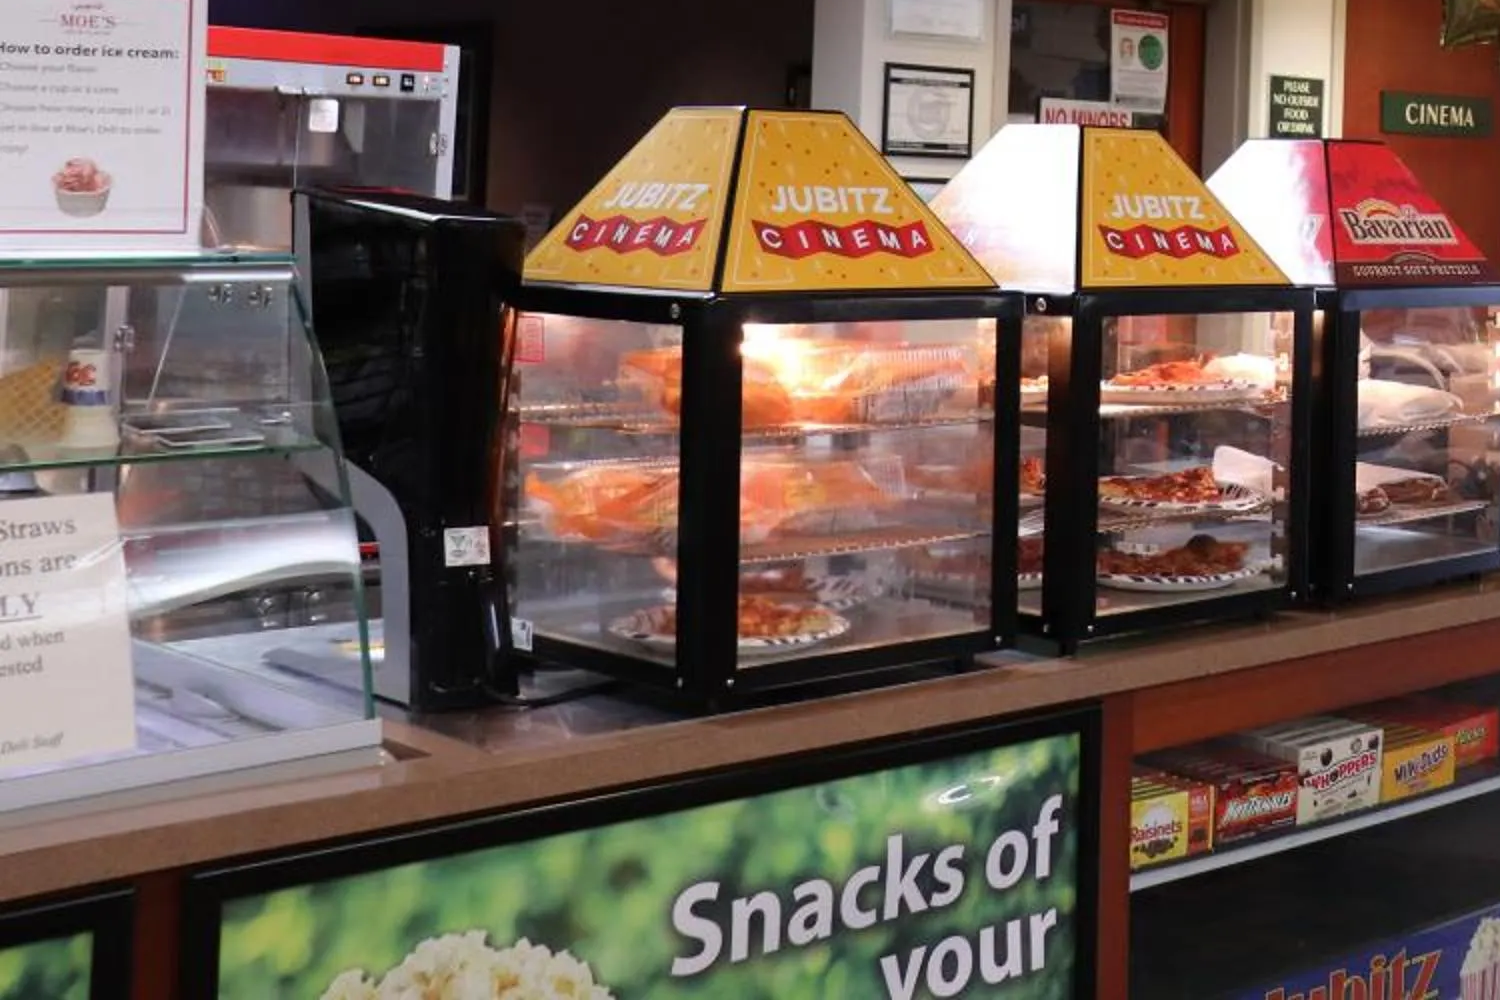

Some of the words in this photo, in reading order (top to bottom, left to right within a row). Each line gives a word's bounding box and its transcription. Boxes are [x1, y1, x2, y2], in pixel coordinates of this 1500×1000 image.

[60, 14, 116, 29] MOE'S
[34, 43, 50, 55] to
[55, 44, 96, 57] order
[101, 45, 122, 57] ice
[127, 48, 180, 60] cream:
[1274, 93, 1287, 105] NO
[1045, 108, 1066, 124] NO
[1071, 109, 1129, 127] MINORS
[1284, 108, 1309, 120] FOOD
[1405, 103, 1475, 127] CINEMA
[605, 182, 713, 212] JUBITZ
[771, 186, 894, 214] JUBITZ
[1110, 194, 1205, 220] JUBITZ
[571, 222, 694, 249] CINEMA
[1344, 211, 1452, 240] Bavarian
[759, 227, 927, 251] CINEMA
[1105, 230, 1235, 252] CINEMA
[40, 553, 77, 574] are
[16, 630, 65, 649] when
[671, 835, 965, 977] Snacks
[985, 794, 1062, 890] of
[880, 907, 1057, 1000] your
